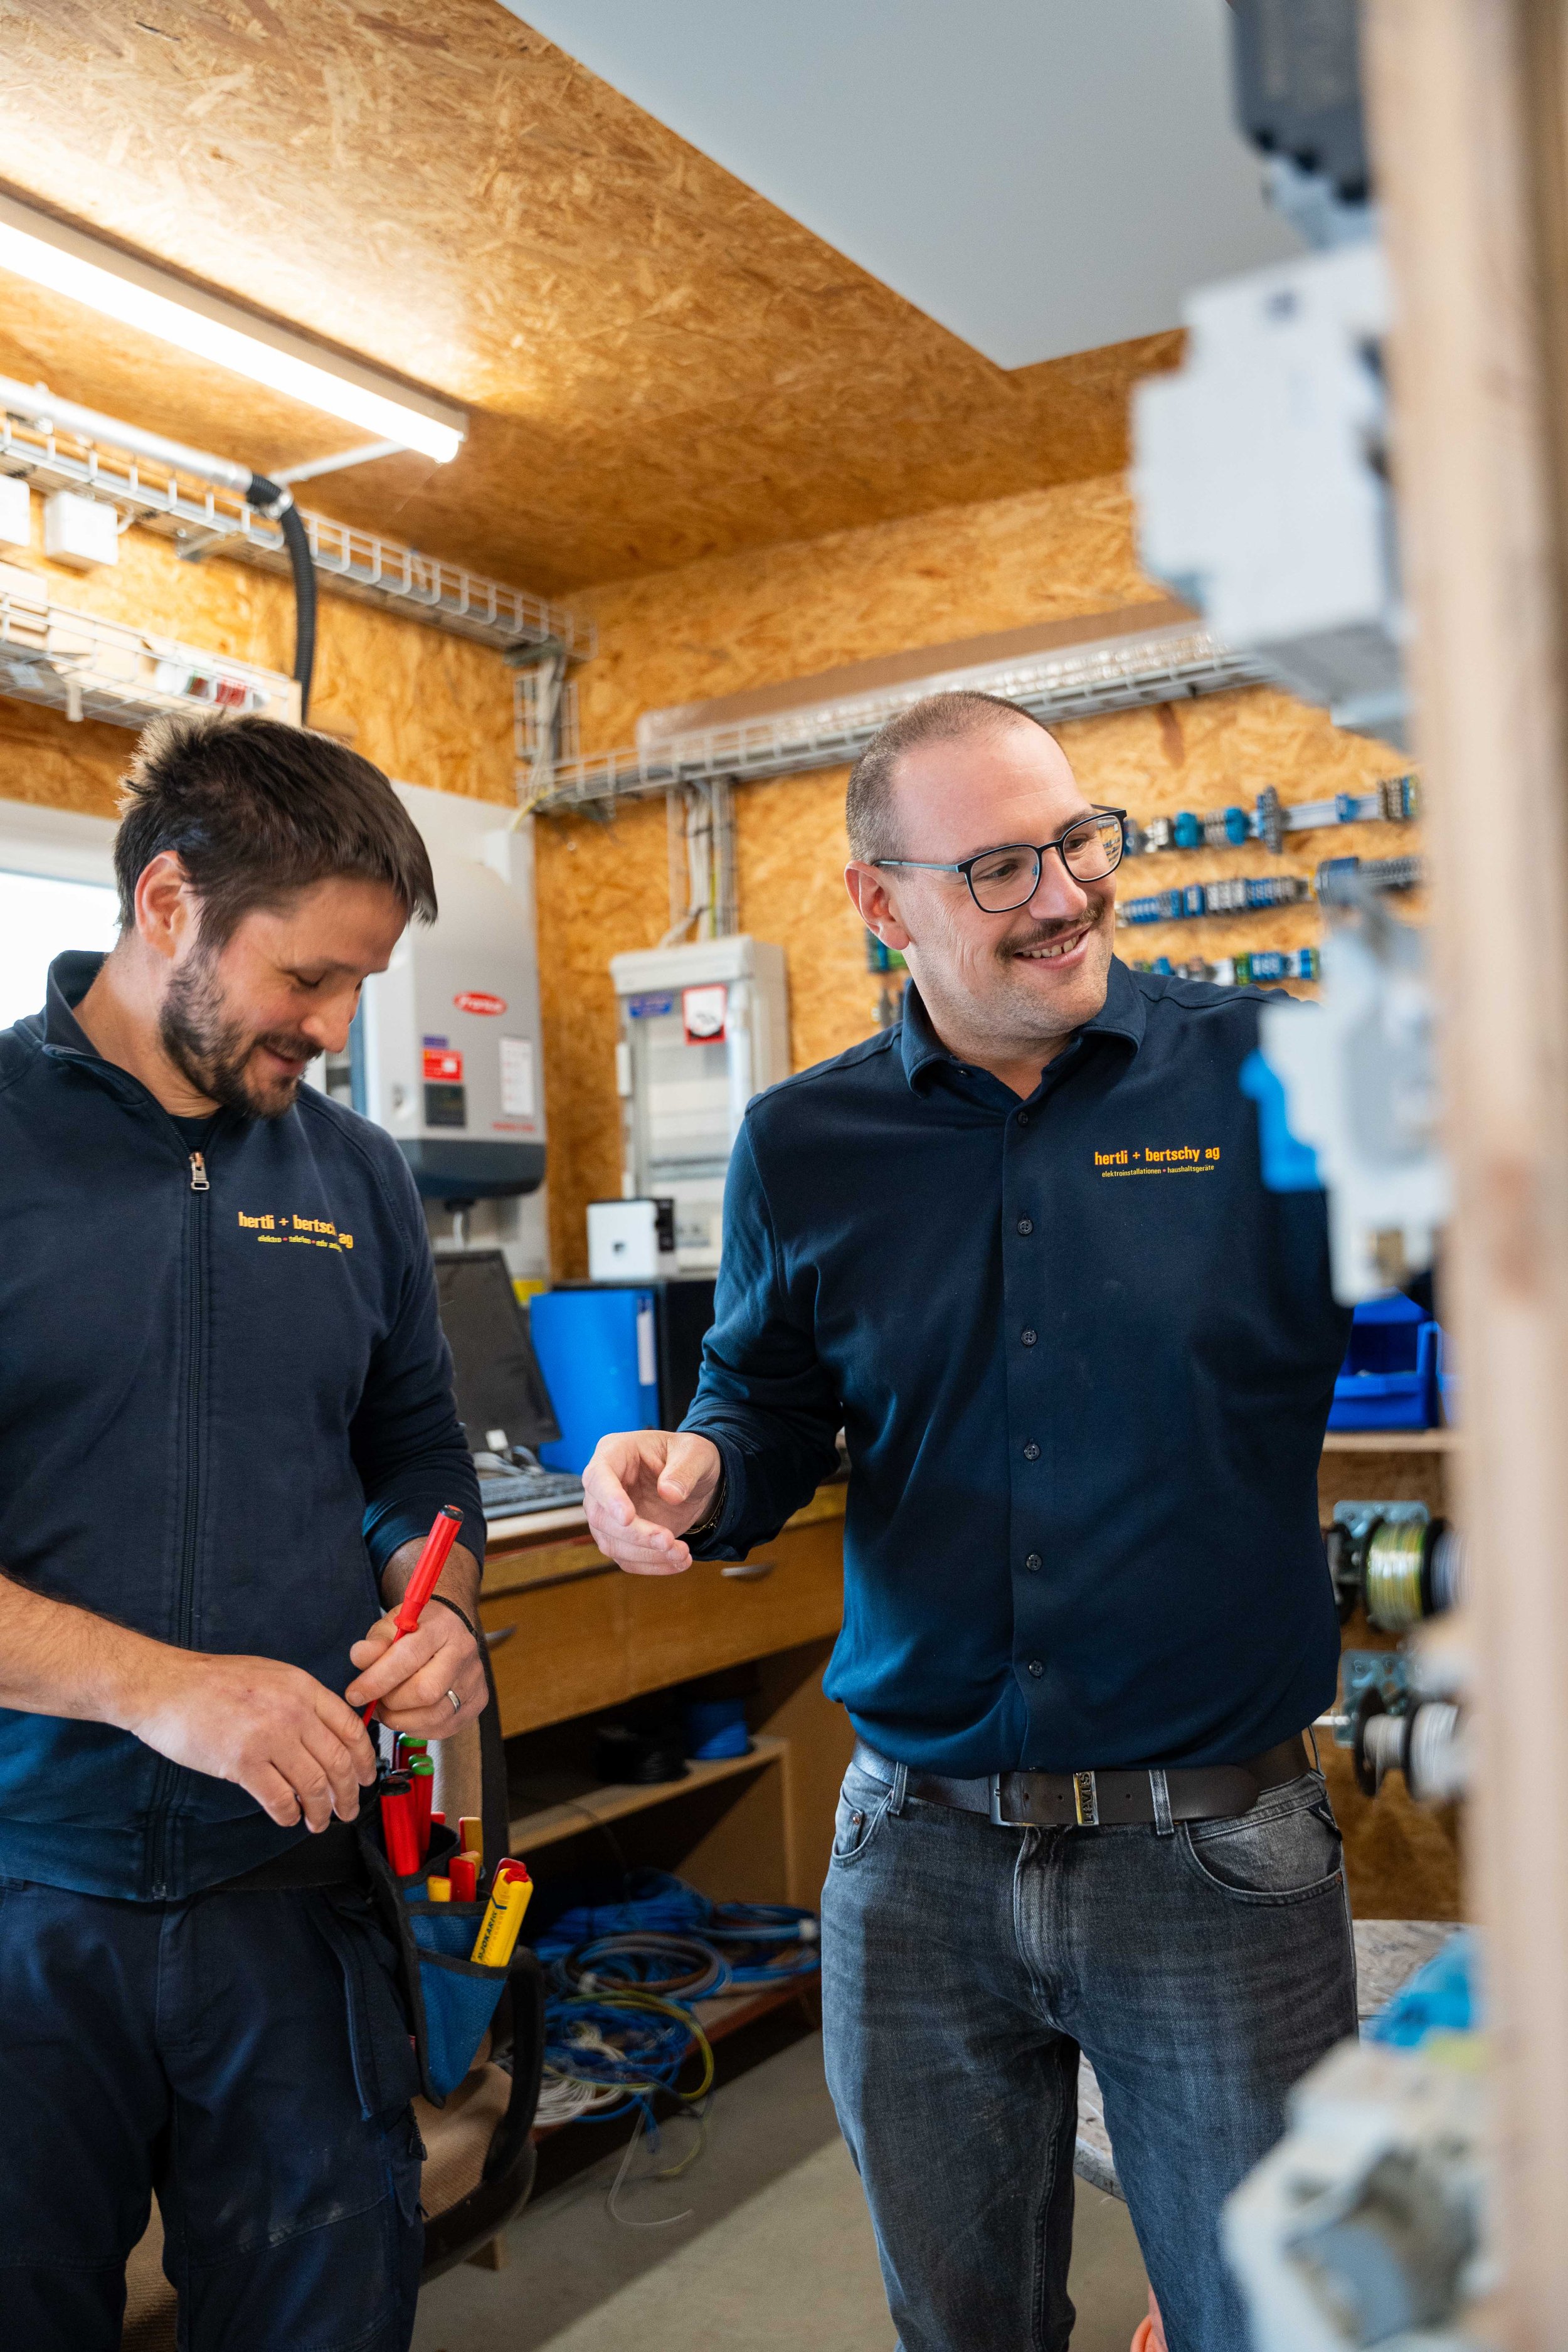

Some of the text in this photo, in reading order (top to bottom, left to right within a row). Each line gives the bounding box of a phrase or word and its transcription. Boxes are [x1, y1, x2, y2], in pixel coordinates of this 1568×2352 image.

[1094, 1150, 1128, 1165] hertli
[1145, 1146, 1200, 1162] bertschy
[1205, 1147, 1220, 1160] ag
[1101, 1165, 1215, 1177] elektroinstallationen haushaltsgeräte
[238, 1211, 275, 1230] hertli
[338, 1233, 354, 1249] ag
